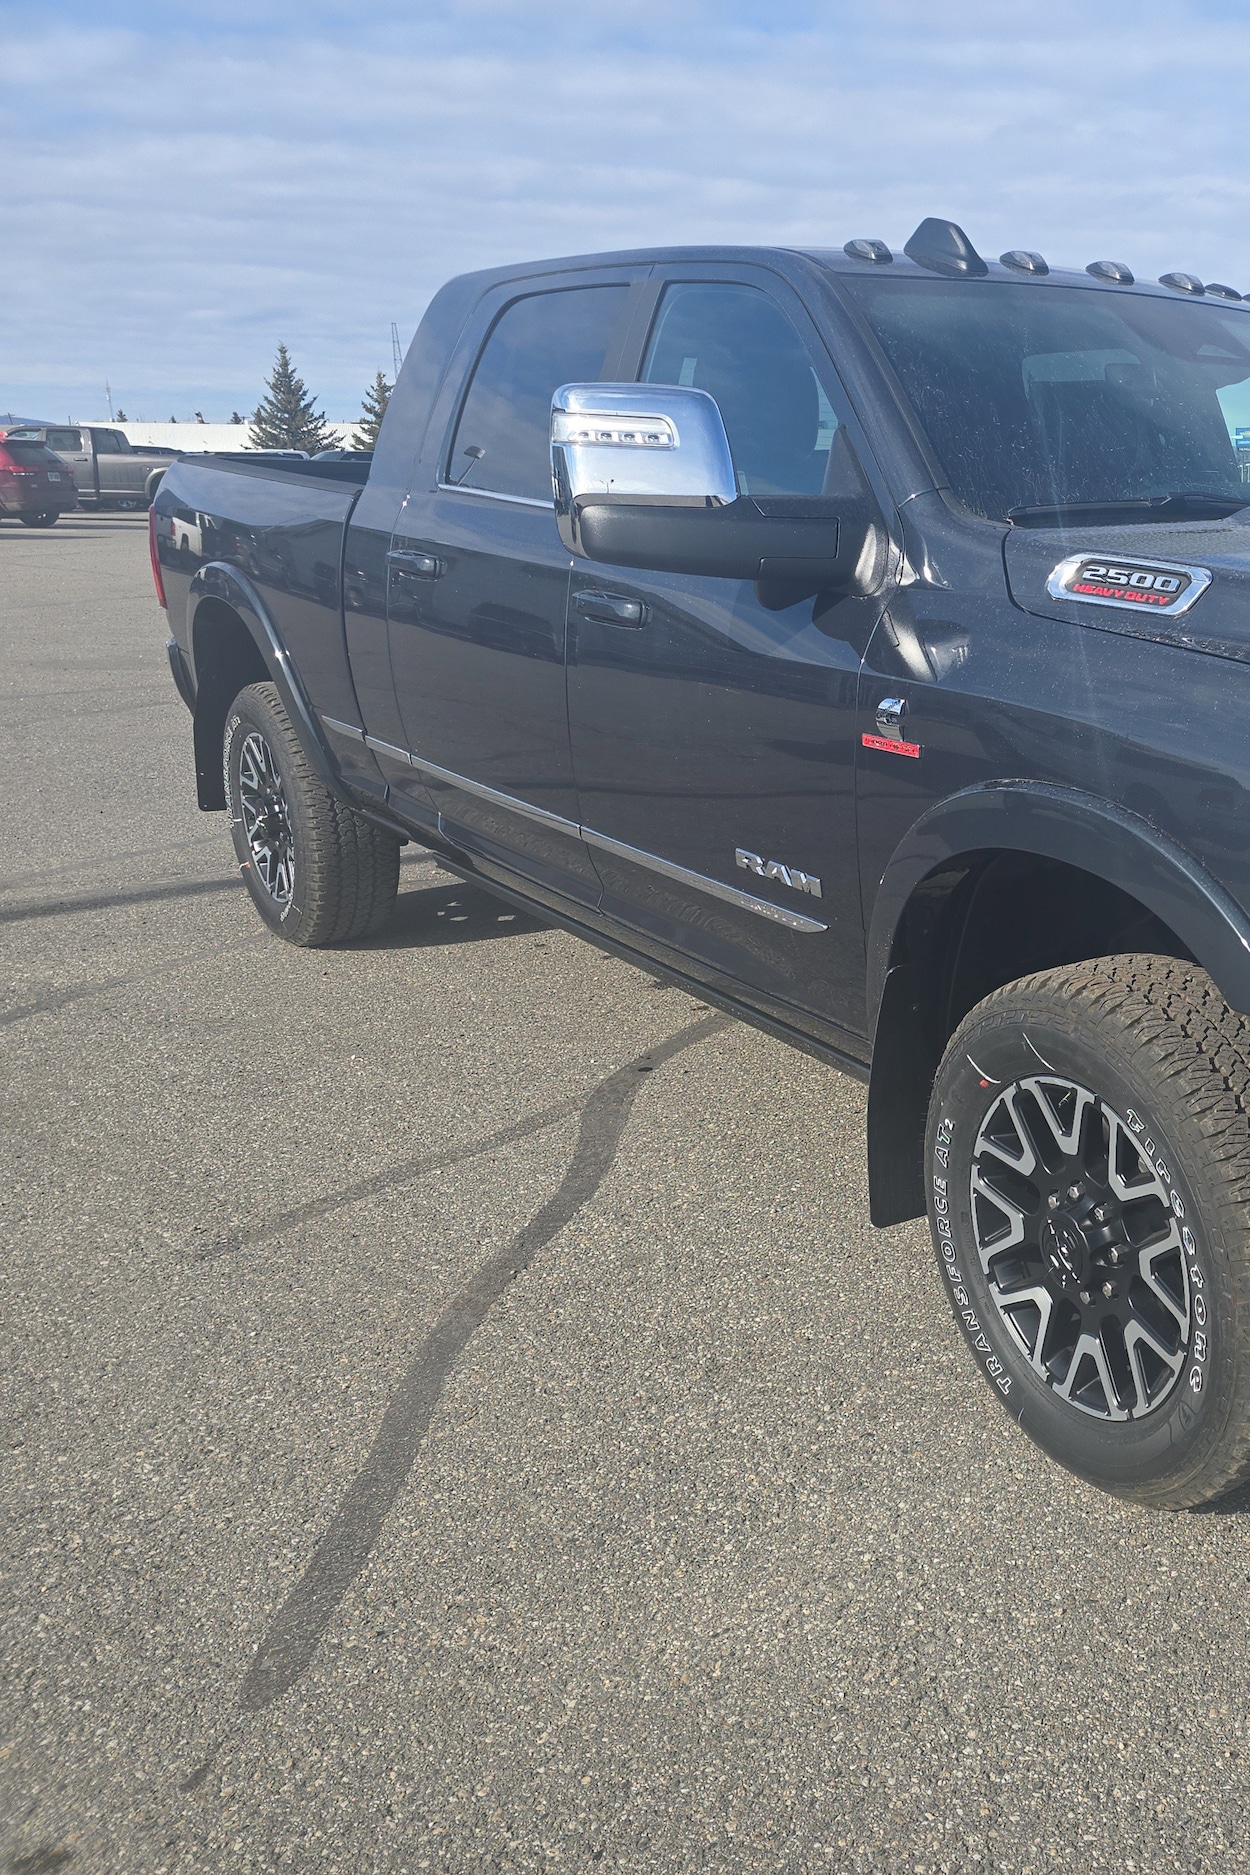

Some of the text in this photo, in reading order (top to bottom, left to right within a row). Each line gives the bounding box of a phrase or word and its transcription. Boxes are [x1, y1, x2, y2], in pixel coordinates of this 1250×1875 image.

[1072, 583, 1170, 605] HEAVY DUTY
[1082, 566, 1181, 593] 2500
[735, 847, 823, 898] RAM
[1126, 1108, 1207, 1393] Firestone
[933, 1176, 1013, 1396] TRANSFORCE
